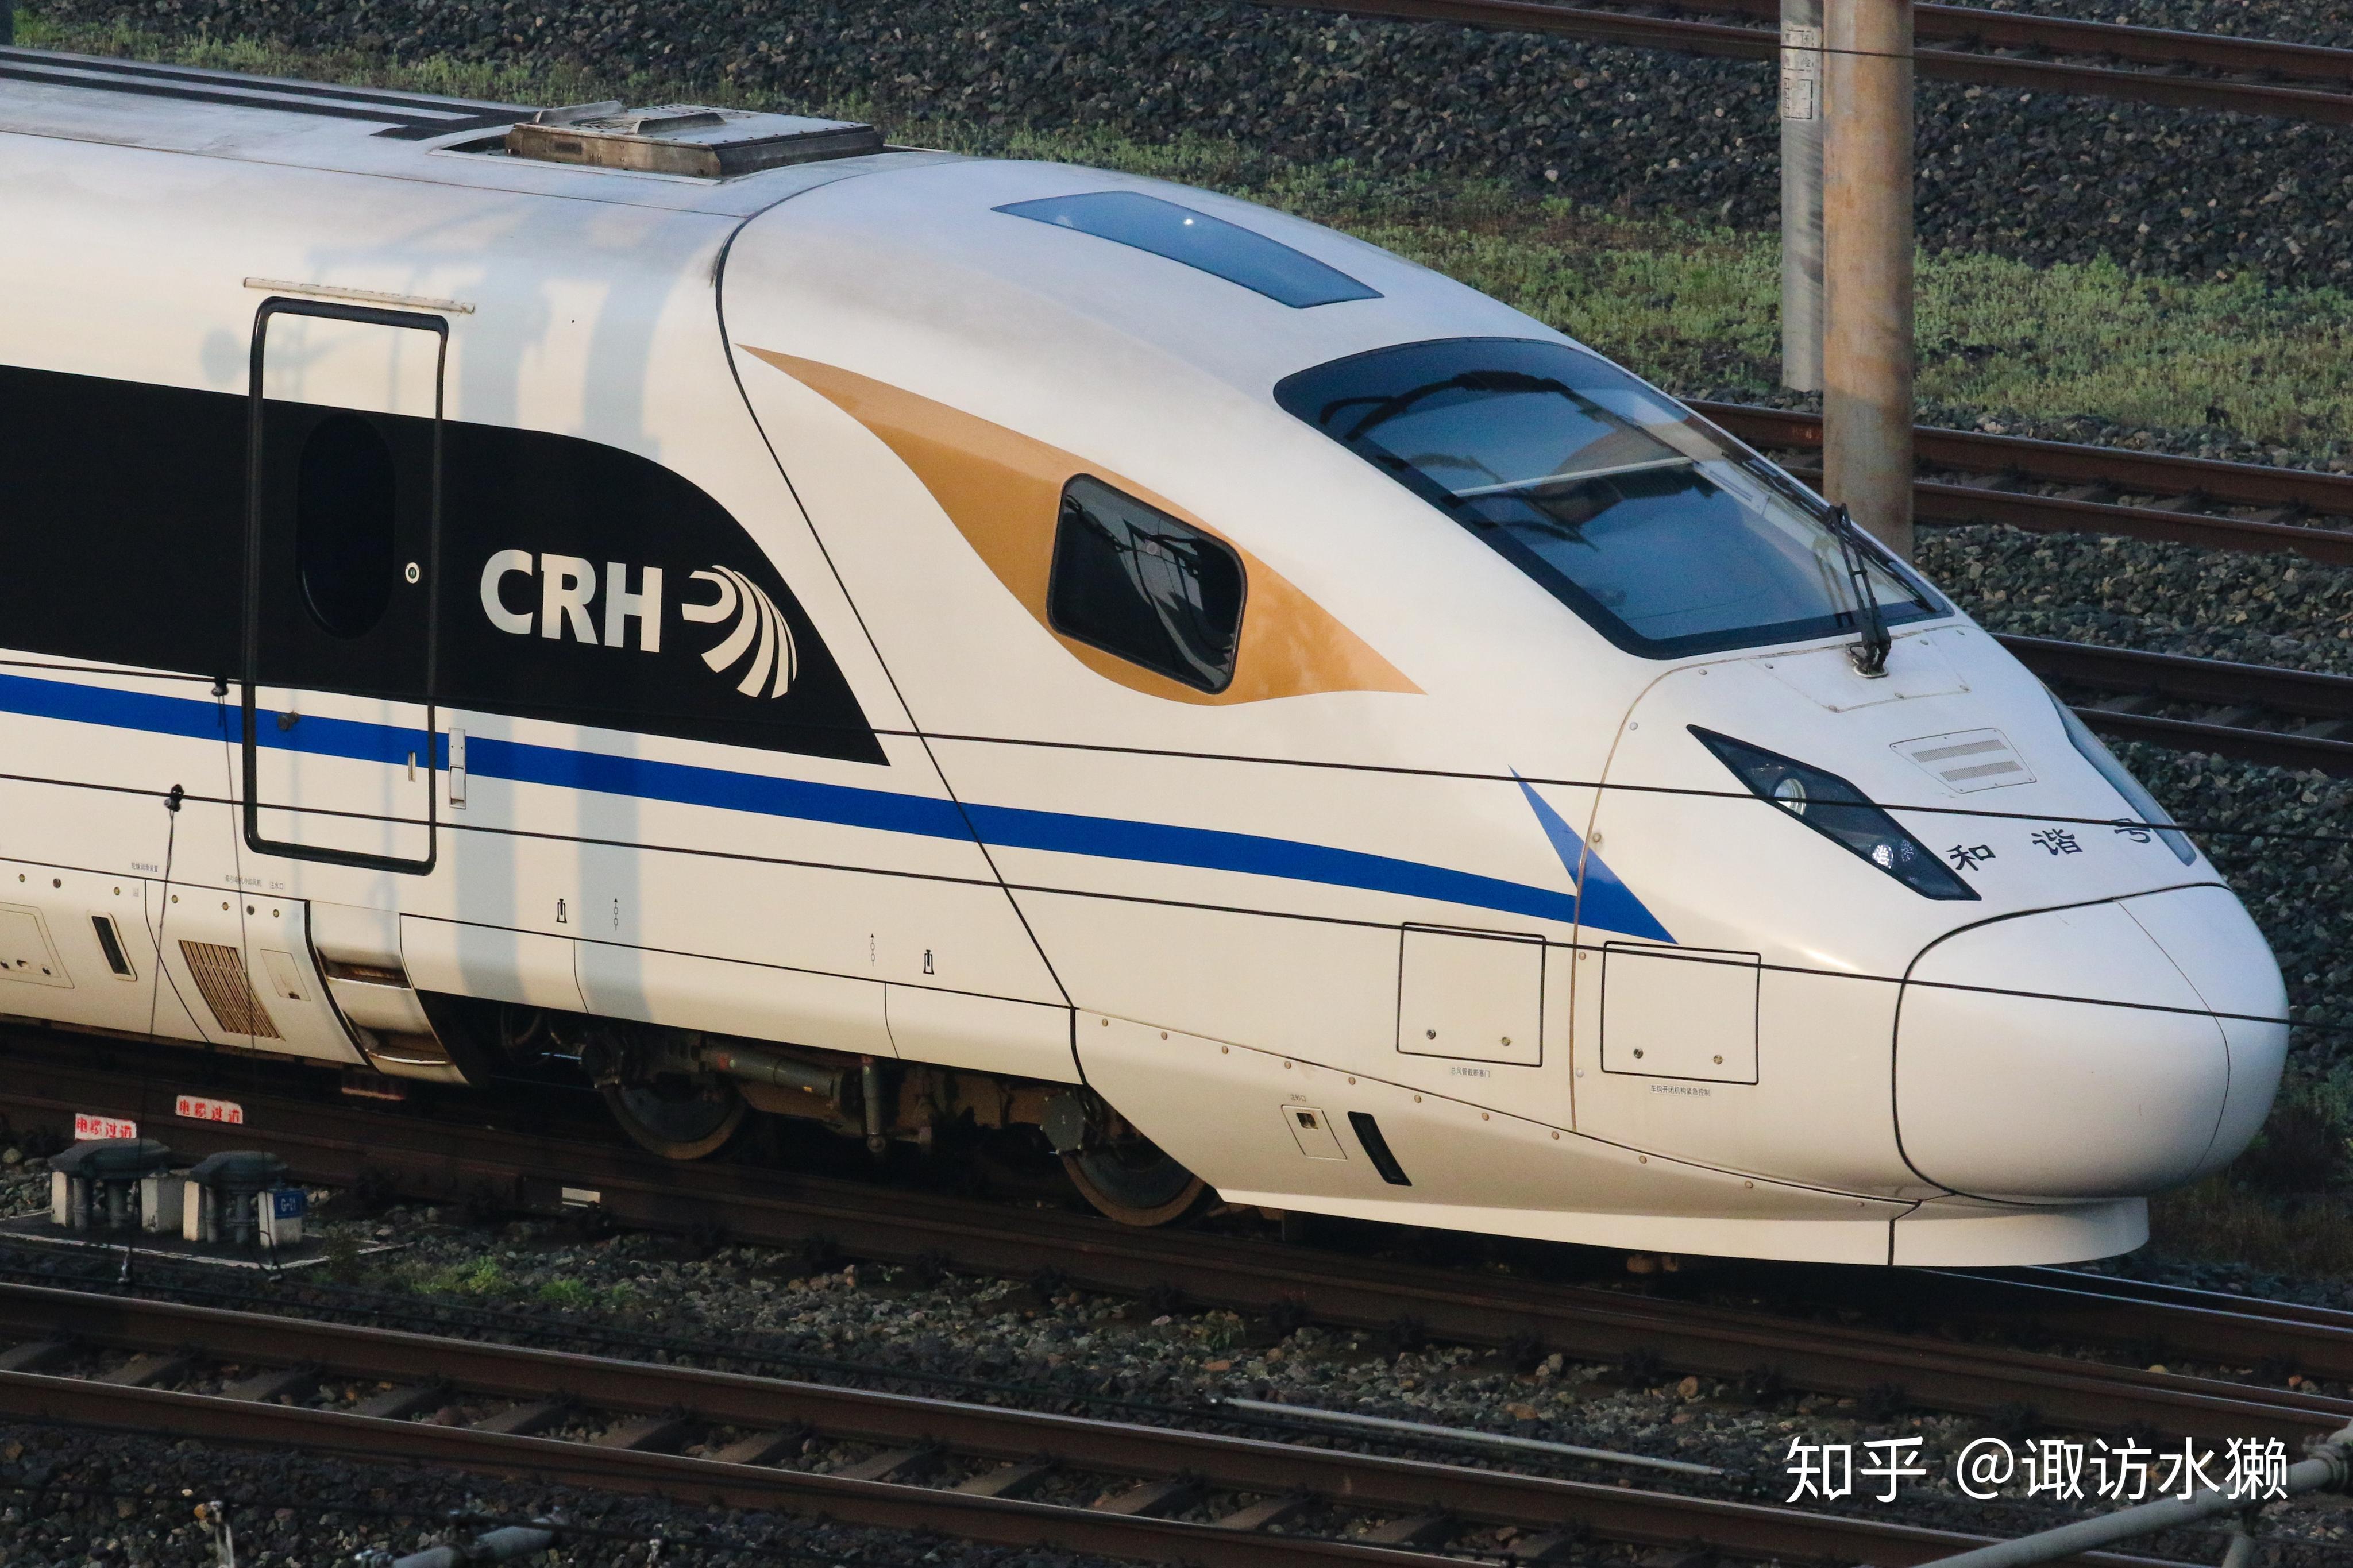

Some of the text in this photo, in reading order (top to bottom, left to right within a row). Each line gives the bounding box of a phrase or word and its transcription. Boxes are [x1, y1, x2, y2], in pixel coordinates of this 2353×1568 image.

[481, 550, 662, 652] CRH
[1946, 818, 2151, 871] 和谐号
